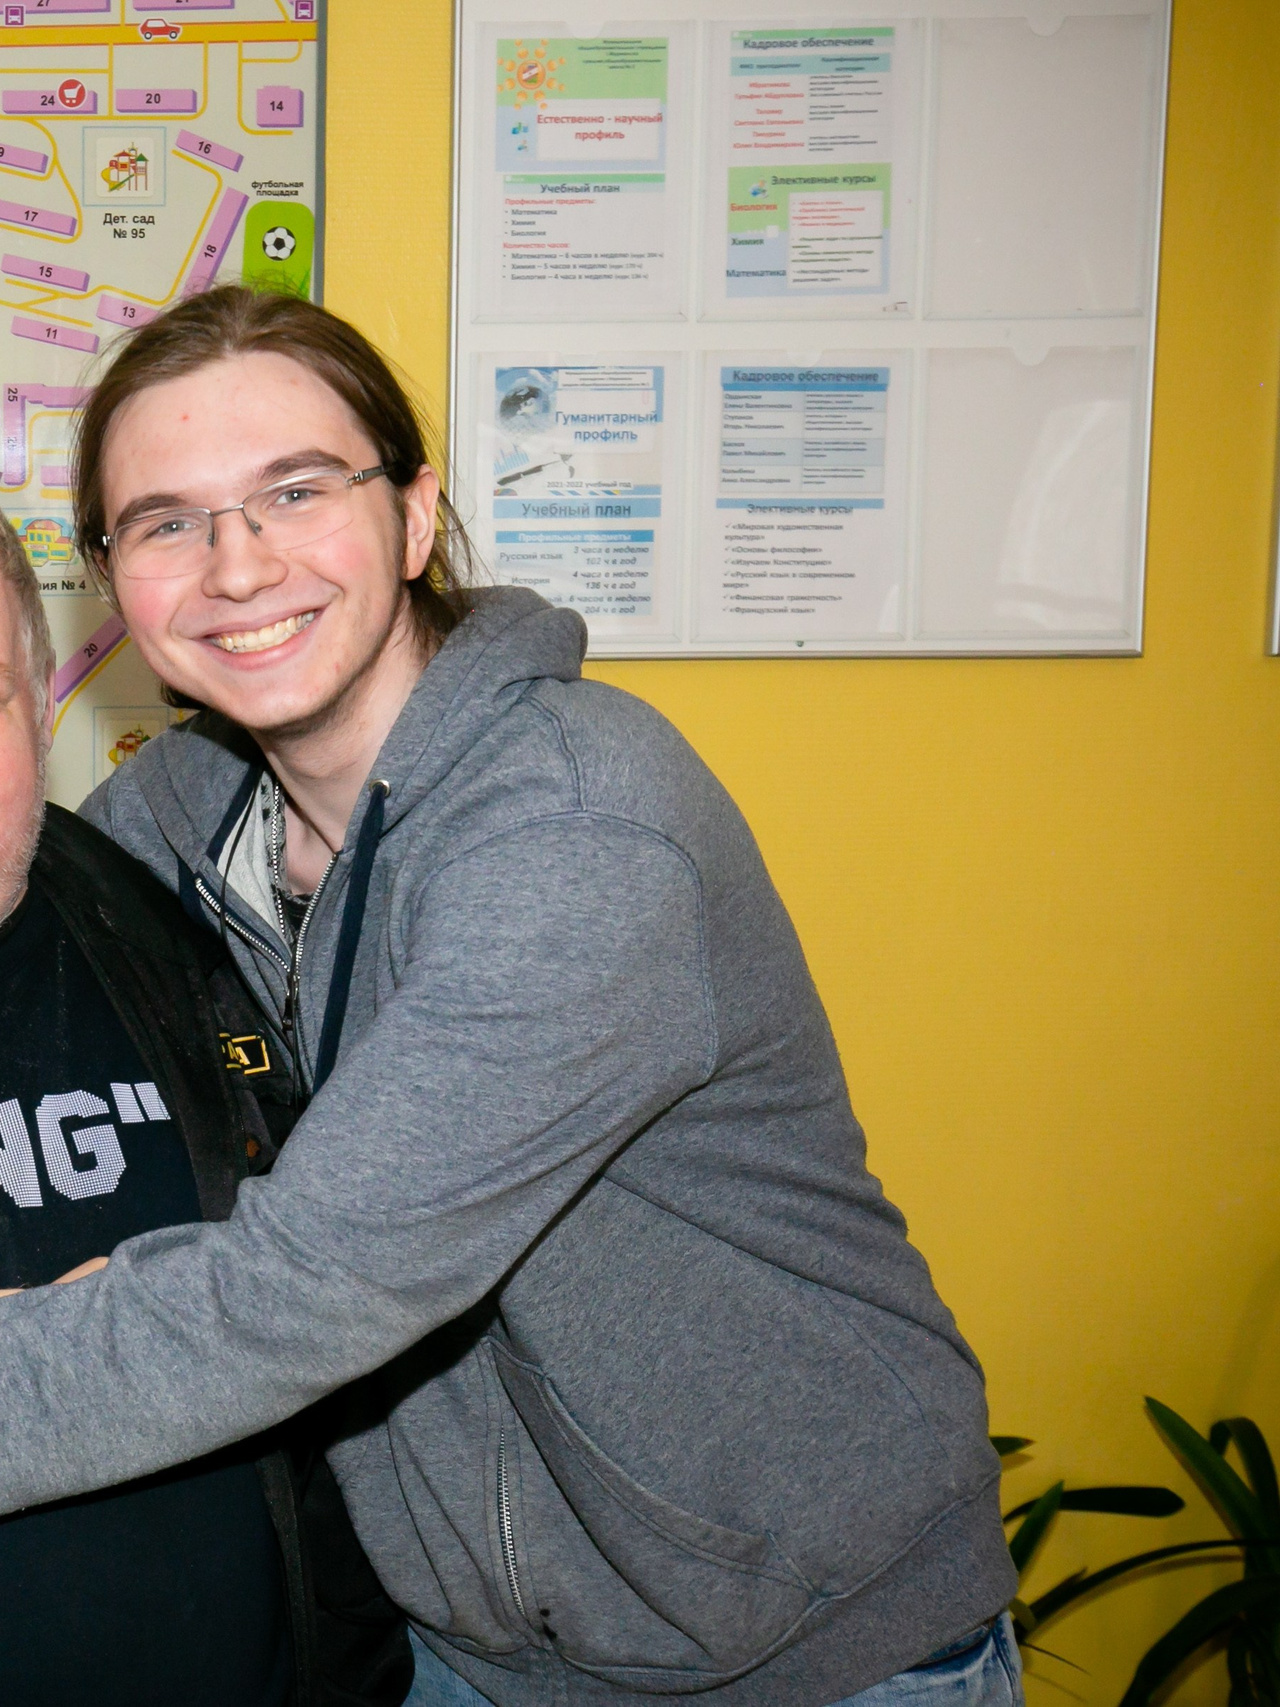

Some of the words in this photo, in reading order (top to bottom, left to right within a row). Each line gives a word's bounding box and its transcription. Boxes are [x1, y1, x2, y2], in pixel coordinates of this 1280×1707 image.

[743, 38, 799, 50] Кадровое
[801, 37, 874, 48] обеспечение
[40, 94, 55, 106] 24
[145, 93, 161, 105] 20
[270, 101, 284, 111] 14
[537, 114, 605, 124] Естественно
[614, 112, 663, 125] научный
[574, 129, 625, 141] профиль
[197, 141, 212, 154] 16
[251, 180, 304, 189] футбольная
[771, 175, 839, 185] Элективные
[842, 175, 876, 185] курсы
[256, 188, 299, 197] площадка
[540, 183, 590, 194] Учебный
[593, 185, 620, 193] план
[730, 202, 778, 212] Биология
[24, 210, 38, 222] 17
[103, 213, 128, 226] Дет.
[132, 214, 155, 226] сад
[112, 228, 128, 239] №
[130, 228, 146, 239] 95
[731, 238, 764, 246] Химия
[204, 244, 218, 259] 18
[38, 266, 52, 277] 15
[726, 269, 787, 278] Математика
[121, 306, 136, 319] 13
[45, 327, 58, 340] 11
[733, 370, 795, 383] Кадровое
[797, 370, 879, 382] обеспечение
[7, 387, 18, 402] 25
[555, 410, 659, 426] Гуманитарный
[574, 429, 638, 442] профиль
[522, 502, 590, 518] Учебный
[595, 504, 631, 516] план
[747, 503, 816, 515] Элективные
[819, 504, 853, 515] курсы
[499, 552, 538, 562] Русский
[61, 580, 76, 590] №
[78, 580, 87, 590] 4
[511, 577, 551, 586] История
[83, 643, 99, 658] 20
